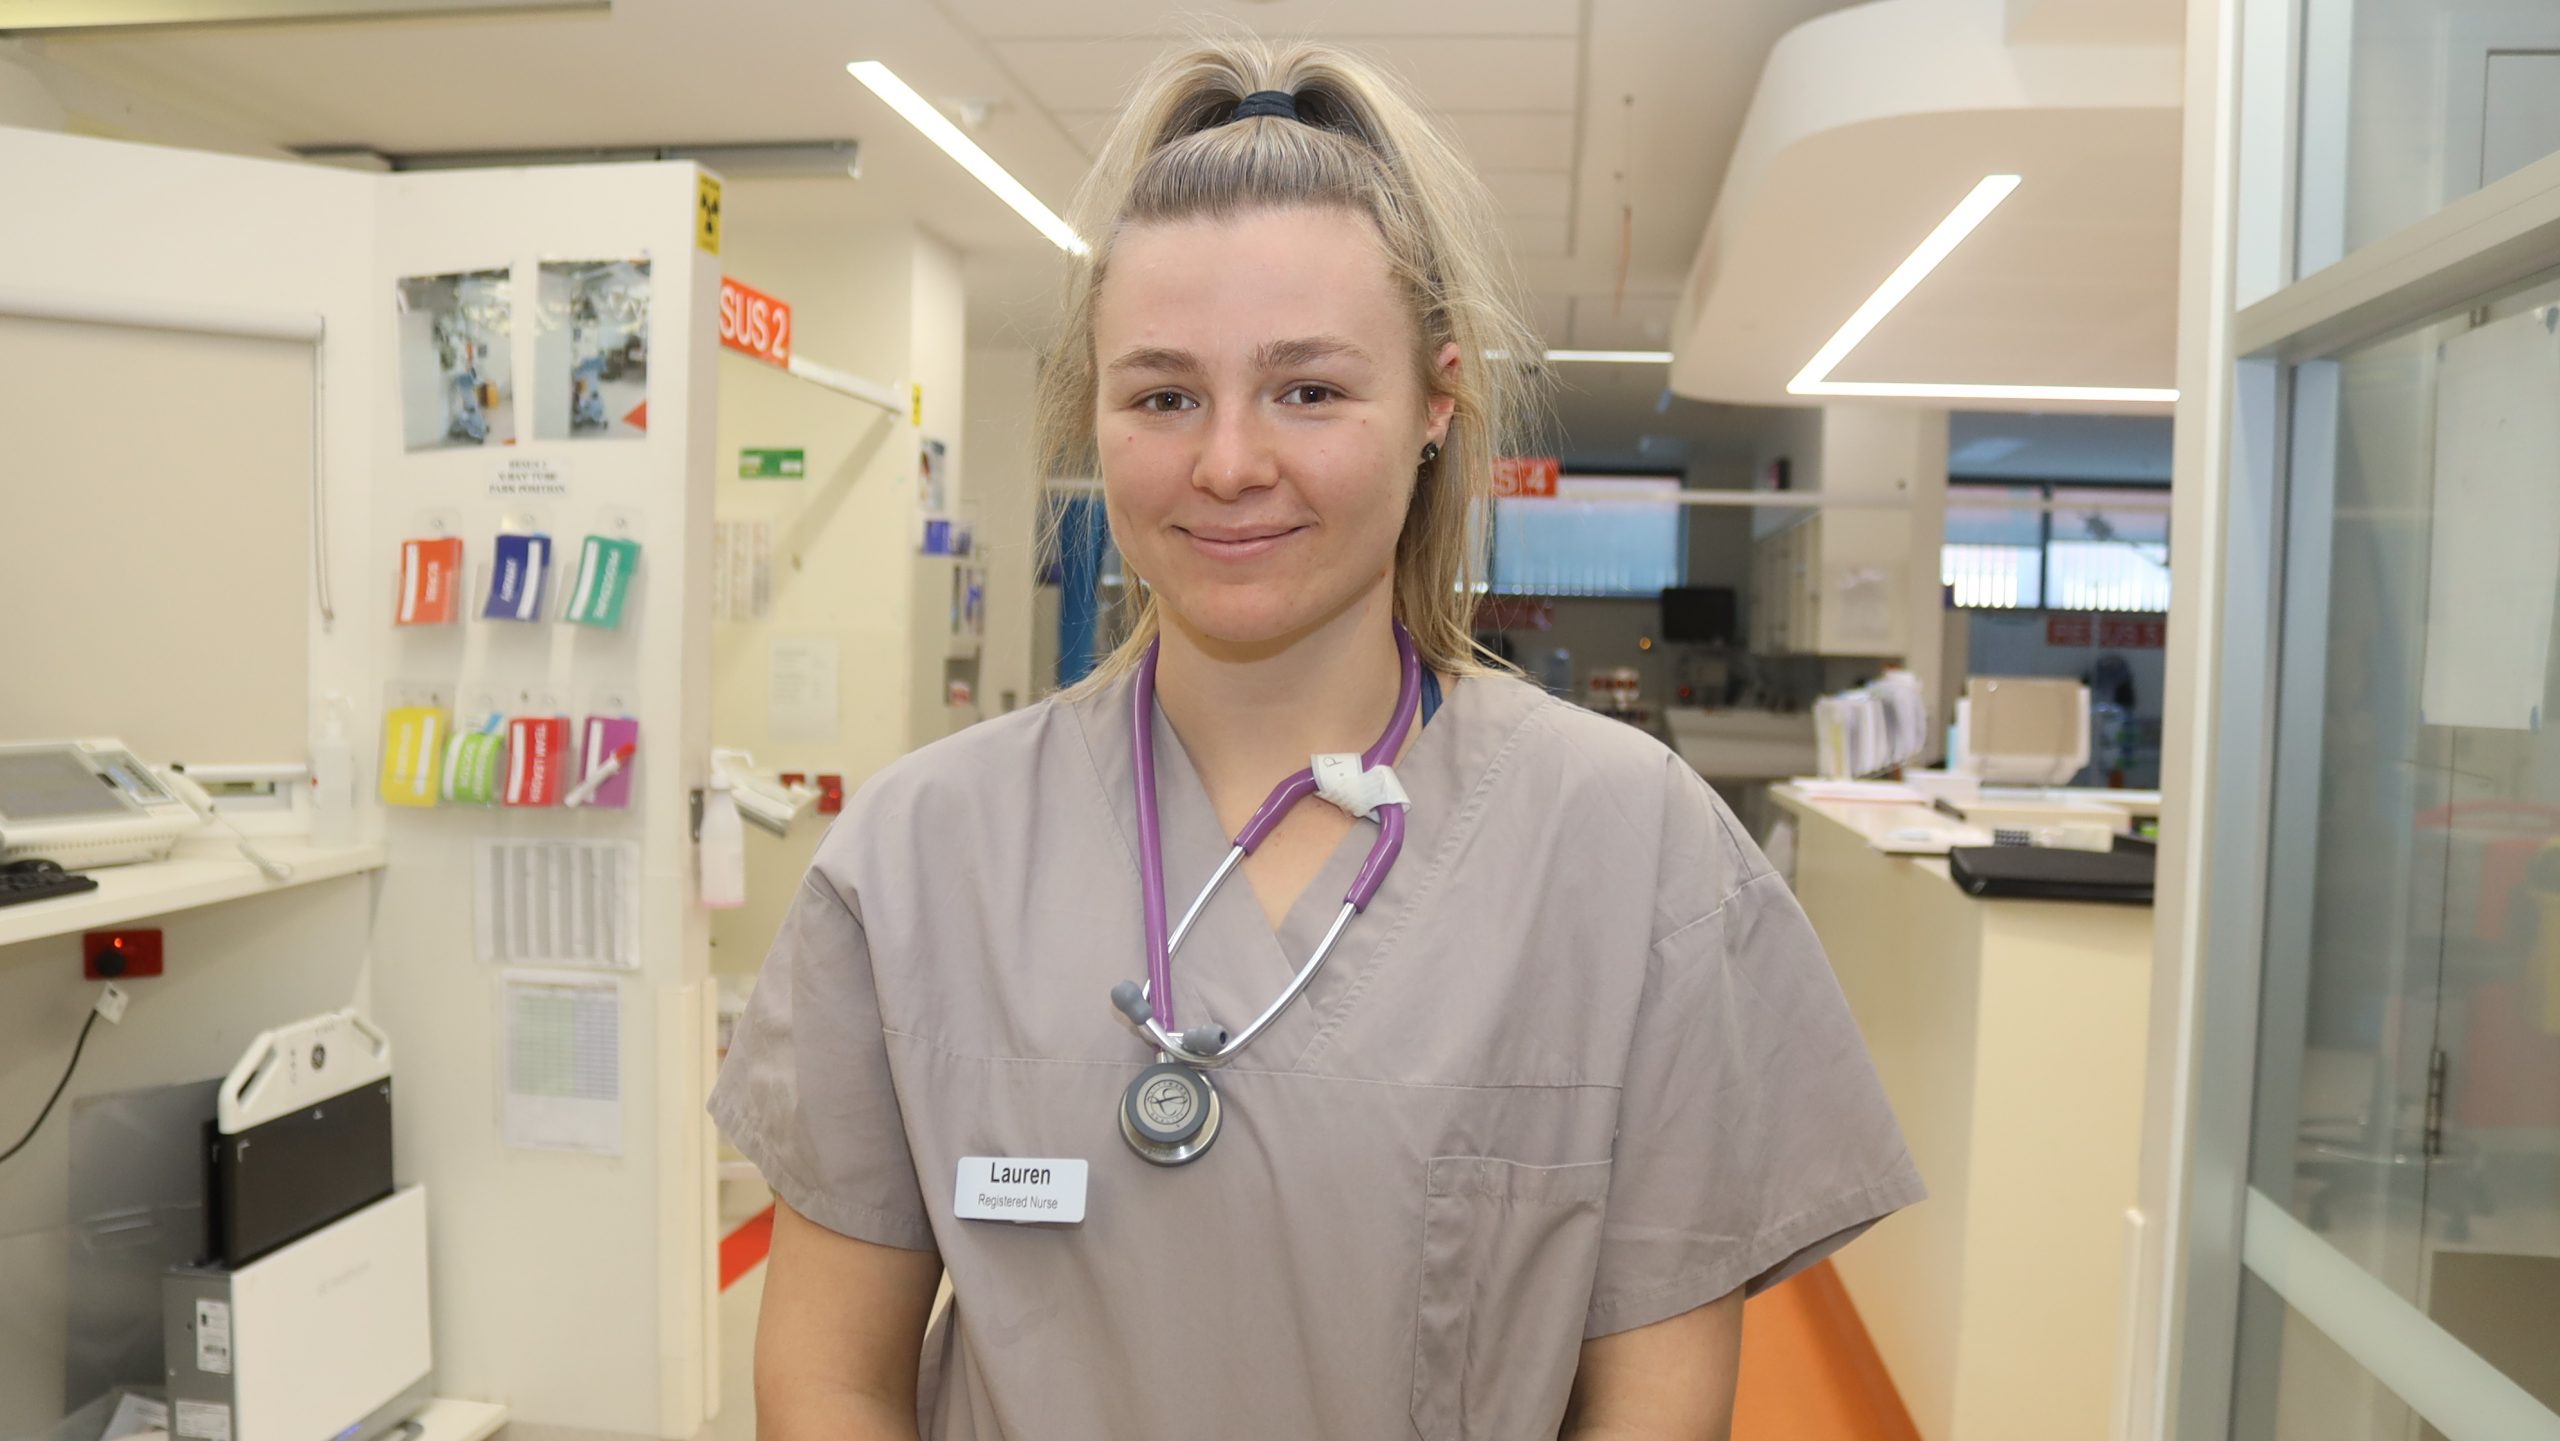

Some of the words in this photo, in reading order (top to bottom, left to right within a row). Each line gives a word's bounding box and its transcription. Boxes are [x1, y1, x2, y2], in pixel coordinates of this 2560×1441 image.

[772, 308, 788, 359] 2
[535, 723, 548, 756] TEAM
[530, 757, 546, 803] LEADER
[990, 1162, 1051, 1184] Lauren
[978, 1193, 1028, 1210] Registered
[1030, 1196, 1058, 1209] Nurse
